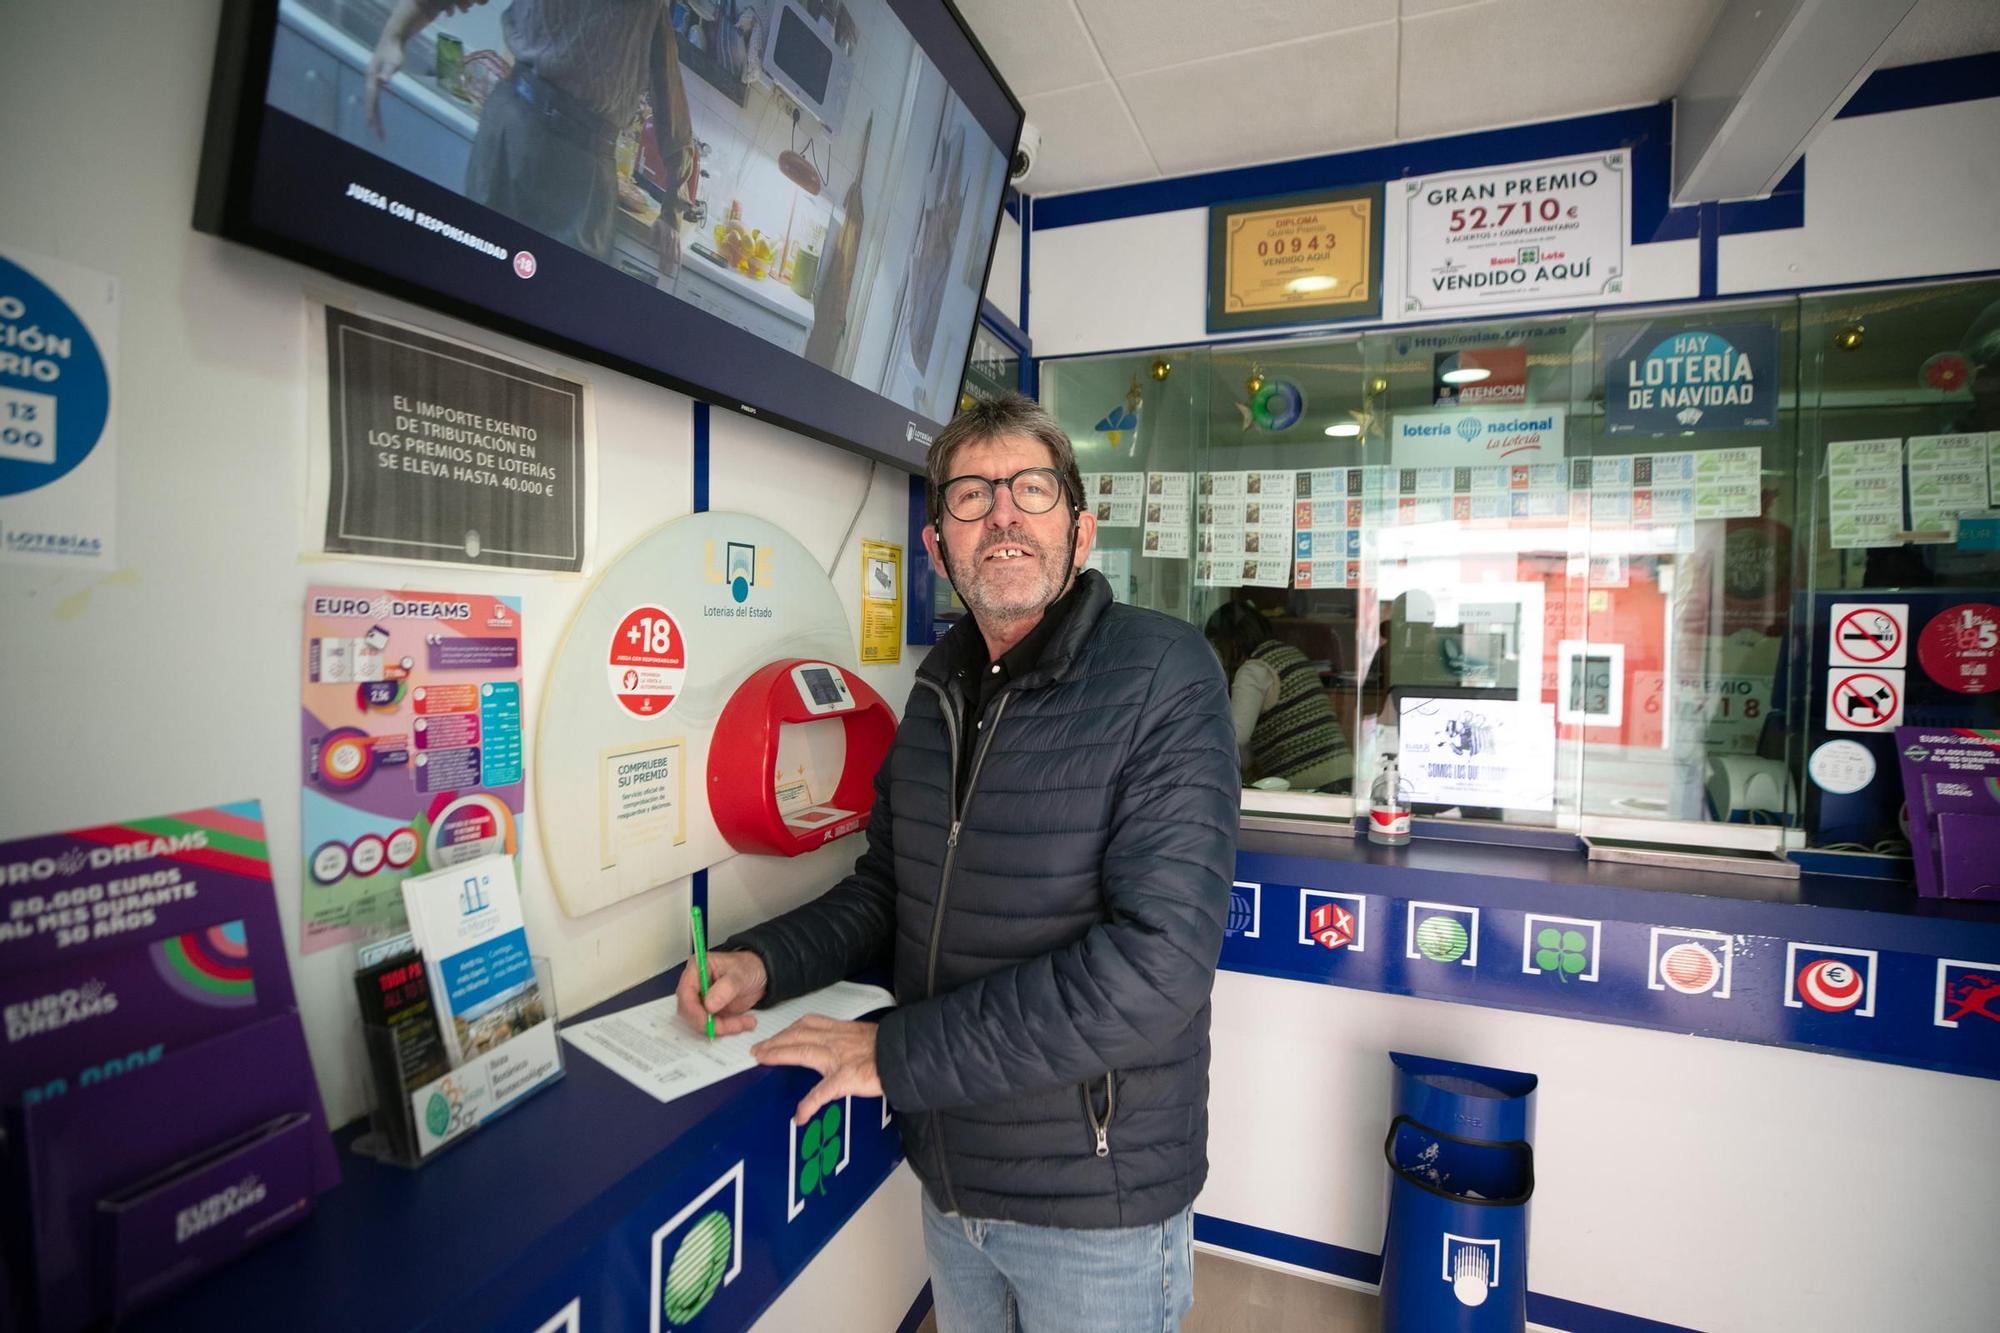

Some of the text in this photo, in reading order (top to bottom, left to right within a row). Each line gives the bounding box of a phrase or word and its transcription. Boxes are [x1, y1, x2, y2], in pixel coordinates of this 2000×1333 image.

[1427, 170, 1598, 206] GRAN PREMIO
[345, 183, 387, 210] JUEGA
[389, 201, 415, 221] CON
[415, 213, 508, 260] RESPONSABILIDAD
[1276, 215, 1318, 228] DIPLOMA
[1452, 231, 1491, 243] ACIERTOS
[1499, 222, 1580, 237] COMPLEMENTARIO
[1263, 255, 1304, 266] VENDIDO
[1432, 257, 1592, 292] VENDIDO AQUÍ
[1675, 335, 1709, 354] HAY
[1628, 345, 1754, 387] LOTERÍA
[1628, 384, 1754, 410] DE NAVIDAD
[393, 395, 537, 442] EL IMPORTE EXENTO
[1403, 416, 1553, 437] lotería nacional
[368, 430, 556, 480] LOS PREMIOS DE LOTERÍAS
[396, 416, 536, 459] DE TRIBUTACIÓN EN
[378, 452, 554, 497] SE ELEVA HASTA 40.000 €
[314, 598, 469, 618] EURO DREAMS
[736, 606, 747, 617] del
[749, 607, 773, 618] Estado
[627, 617, 671, 654] +18
[618, 757, 668, 775] COMPRUEBE
[618, 768, 668, 788] SU PREMIO
[90, 830, 209, 870] DREAMS
[10, 867, 182, 919] 20.000 EUROS
[37, 904, 90, 933] MES
[92, 881, 198, 919] DURANTE
[56, 925, 90, 949] 30
[3, 988, 80, 1021] EURO
[8, 993, 118, 1043] DREAMS
